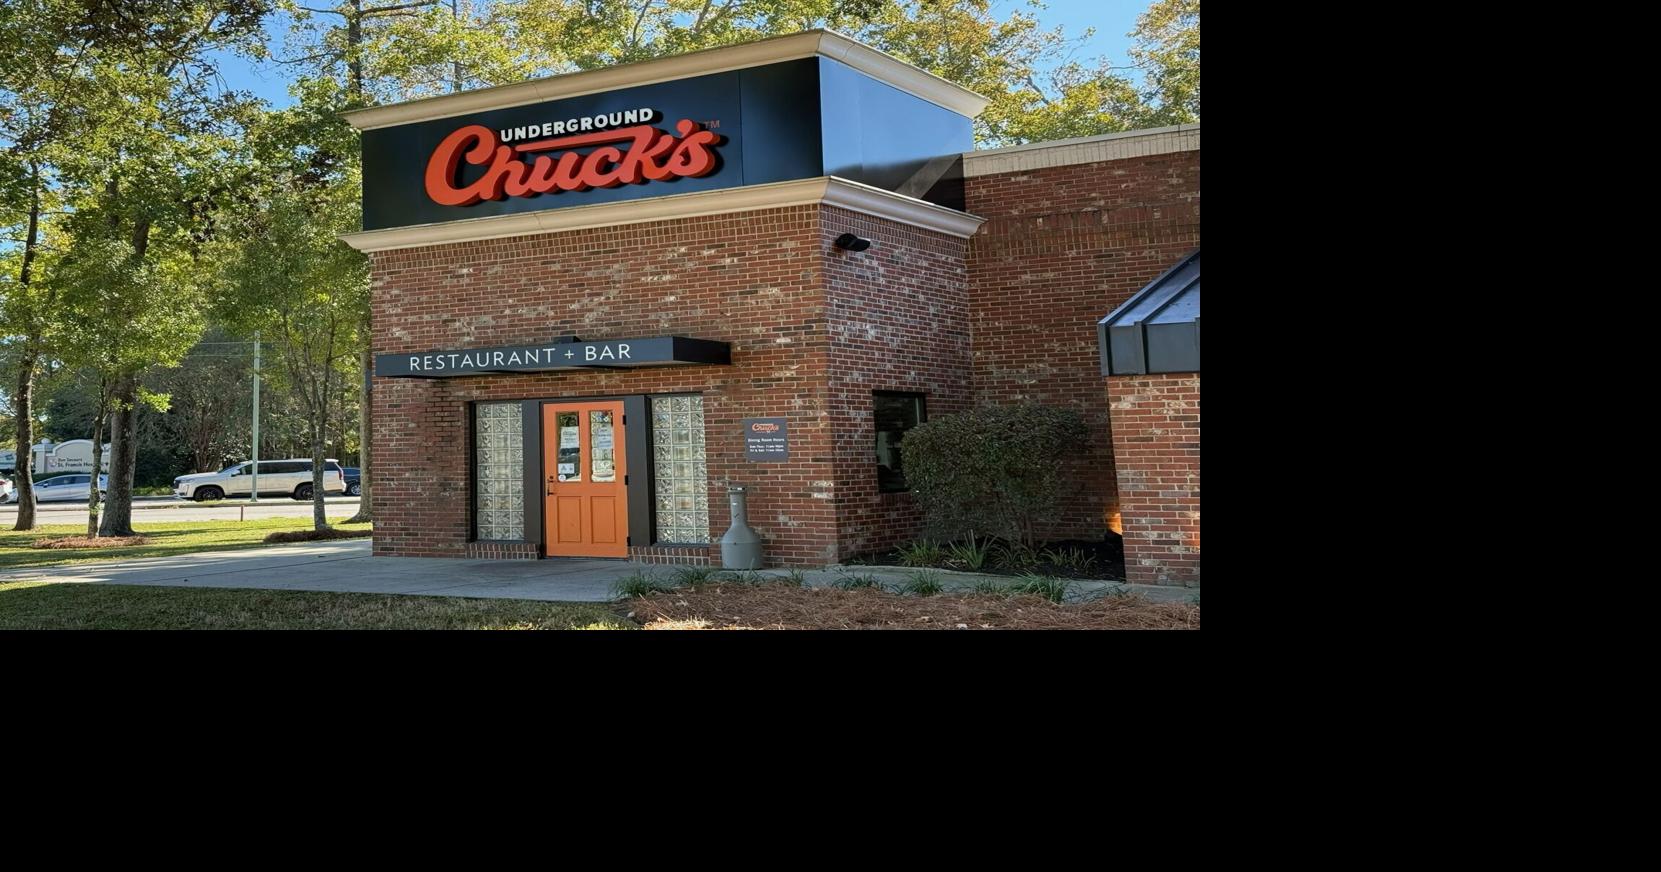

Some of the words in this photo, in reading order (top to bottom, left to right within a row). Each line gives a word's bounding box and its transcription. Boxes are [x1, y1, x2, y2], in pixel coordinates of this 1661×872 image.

[500, 107, 654, 142] UNDERGROUND
[424, 119, 721, 206] Chuck's
[409, 348, 555, 371] RESTAURANT
[584, 343, 632, 361] BAR
